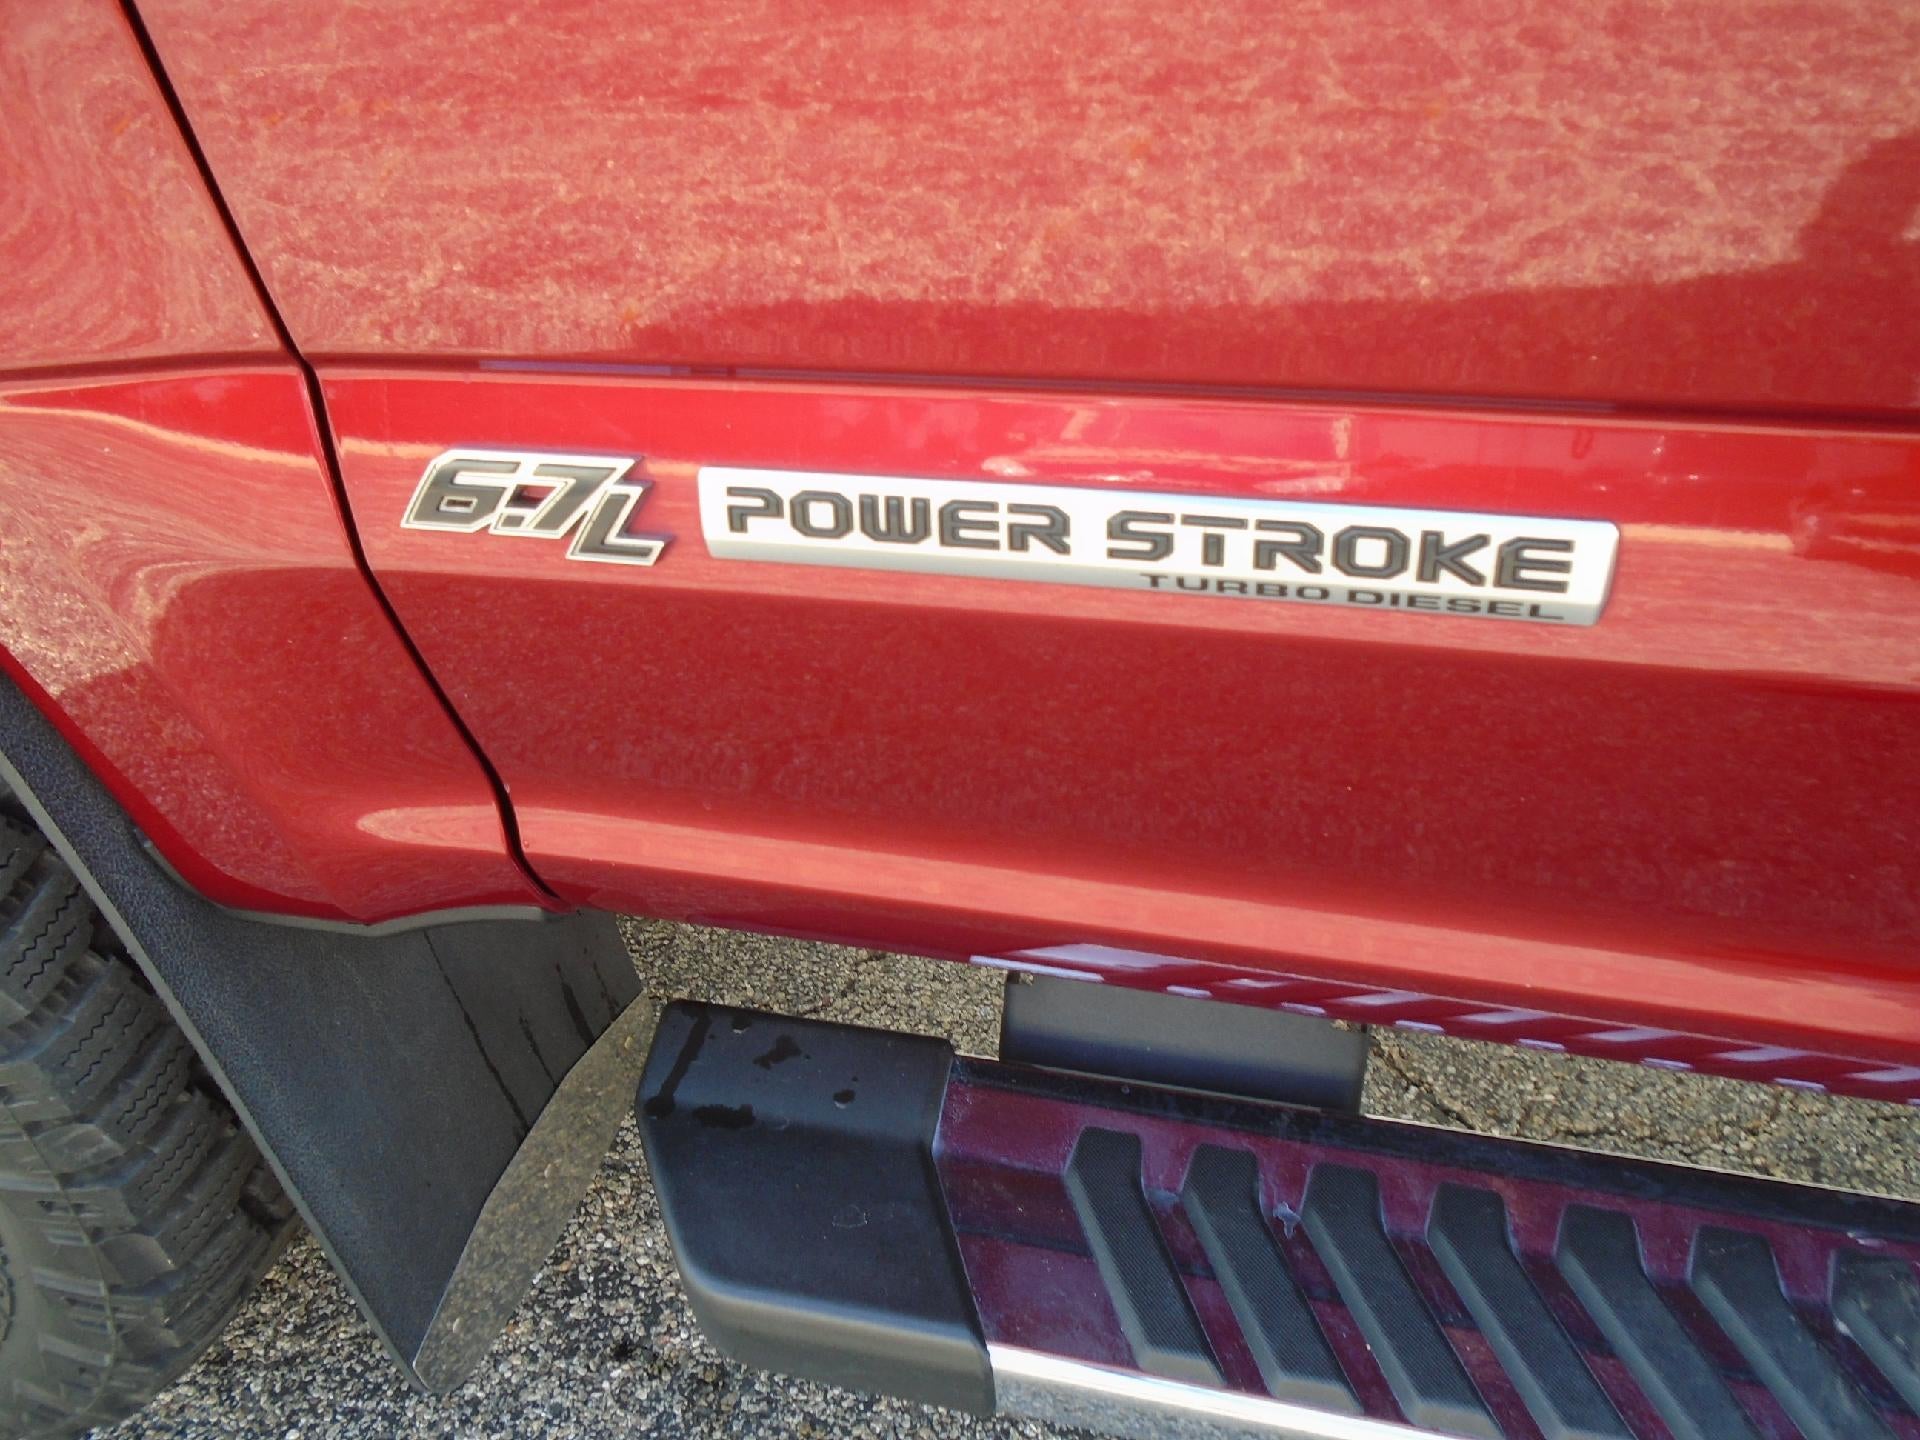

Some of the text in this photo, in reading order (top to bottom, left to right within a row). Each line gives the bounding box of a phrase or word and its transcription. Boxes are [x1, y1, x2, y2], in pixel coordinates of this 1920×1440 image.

[401, 449, 665, 566] 6.7L
[726, 485, 1575, 593] POWER STROKE
[1139, 573, 1566, 620] TURBO DIESEL
